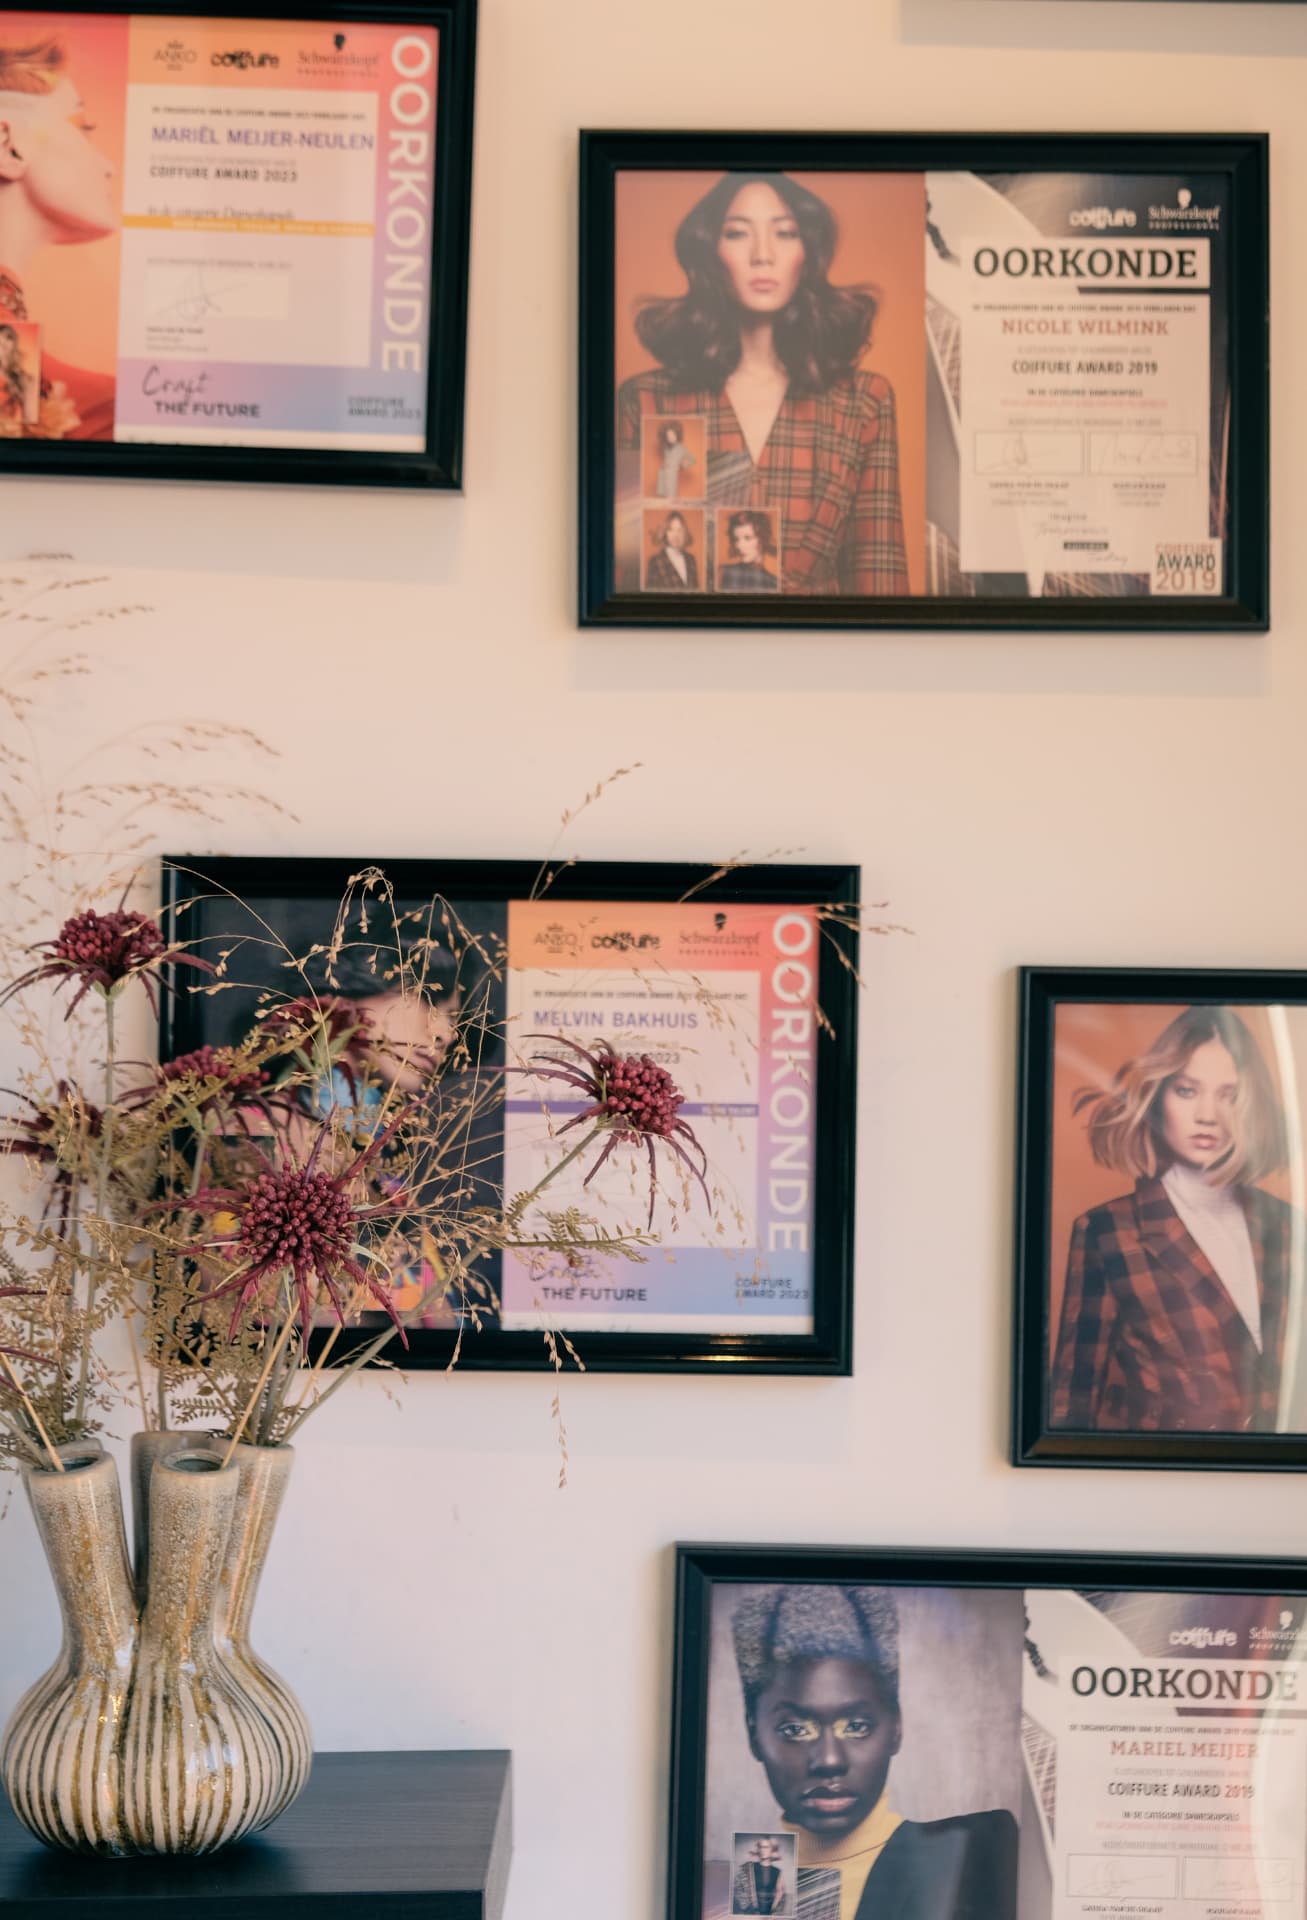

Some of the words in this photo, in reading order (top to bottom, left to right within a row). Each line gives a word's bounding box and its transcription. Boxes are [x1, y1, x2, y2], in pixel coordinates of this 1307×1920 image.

[151, 126, 218, 145] MARIËL
[226, 128, 373, 150] MEIJER-NEULEN
[150, 166, 208, 180] COIFFURE
[214, 168, 259, 182] AWARD
[382, 34, 432, 372] OORKONDE
[973, 248, 1198, 278] OORKONDE
[1002, 319, 1073, 335] NICOLE
[1078, 320, 1169, 336] WILMINK
[1012, 359, 1071, 375] COIFFURE
[1076, 360, 1124, 375] AWARD
[155, 400, 189, 416] THE
[192, 402, 261, 418] FUTURE
[1156, 553, 1216, 571] AWARD
[1156, 568, 1216, 592] 2019
[534, 1010, 604, 1027] MELVIN
[613, 1011, 699, 1029] BAKHUIS
[767, 912, 814, 1253] OORKONDE
[542, 1287, 575, 1300] THE
[580, 1288, 648, 1301] FUTURE
[1071, 1666, 1297, 1701] OORKONDE
[1191, 1742, 1260, 1761] MEIJER
[1107, 1782, 1168, 1797] COIFFURE
[1172, 1783, 1221, 1798] AWARD
